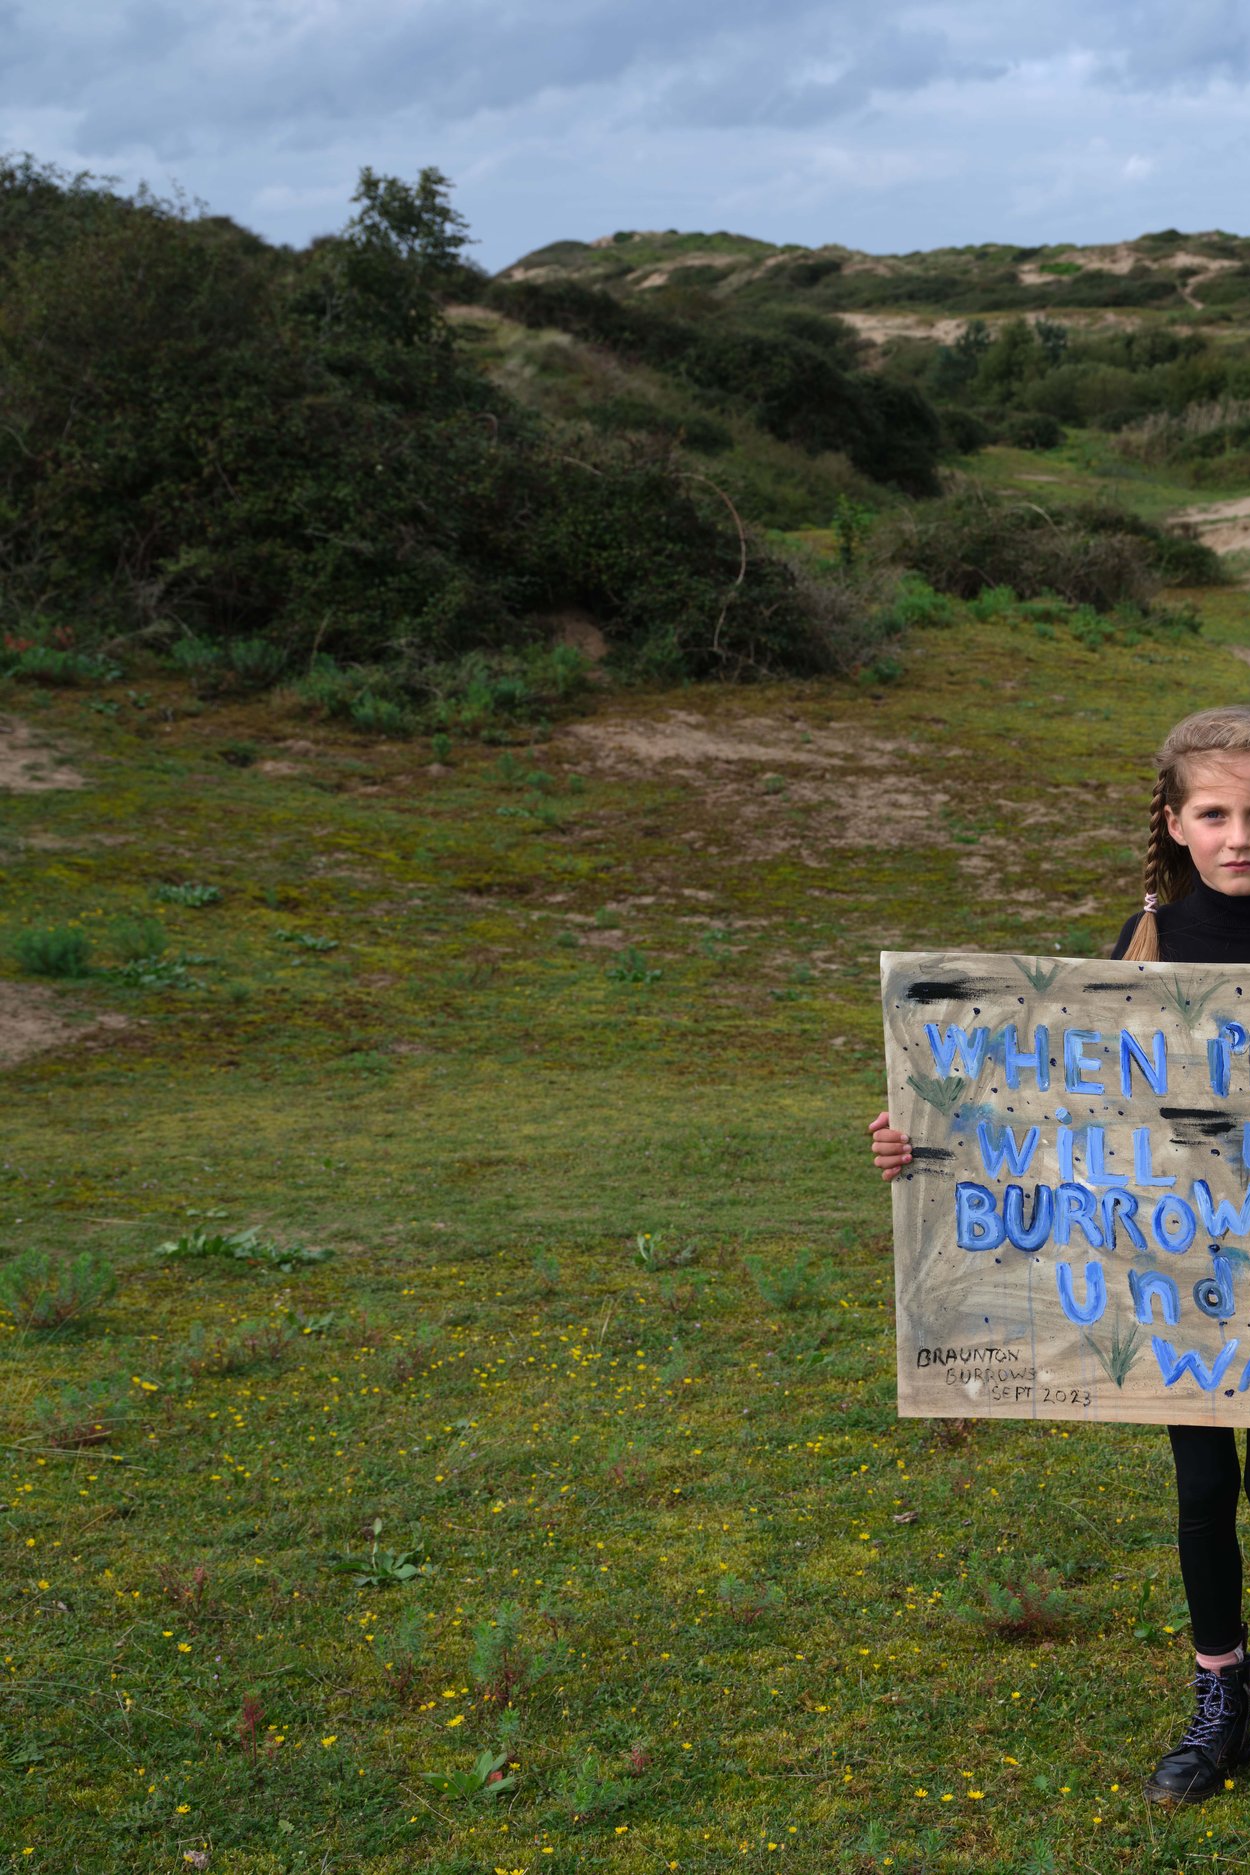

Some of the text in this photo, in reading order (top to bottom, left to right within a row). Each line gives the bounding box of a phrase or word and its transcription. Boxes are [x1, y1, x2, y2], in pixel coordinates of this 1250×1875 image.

[924, 1023, 1169, 1099] WHEN
[917, 1347, 1020, 1369] BRAUNTON
[945, 1367, 1037, 1386] BURROWS
[991, 1385, 1092, 1407] SEPT 2023
